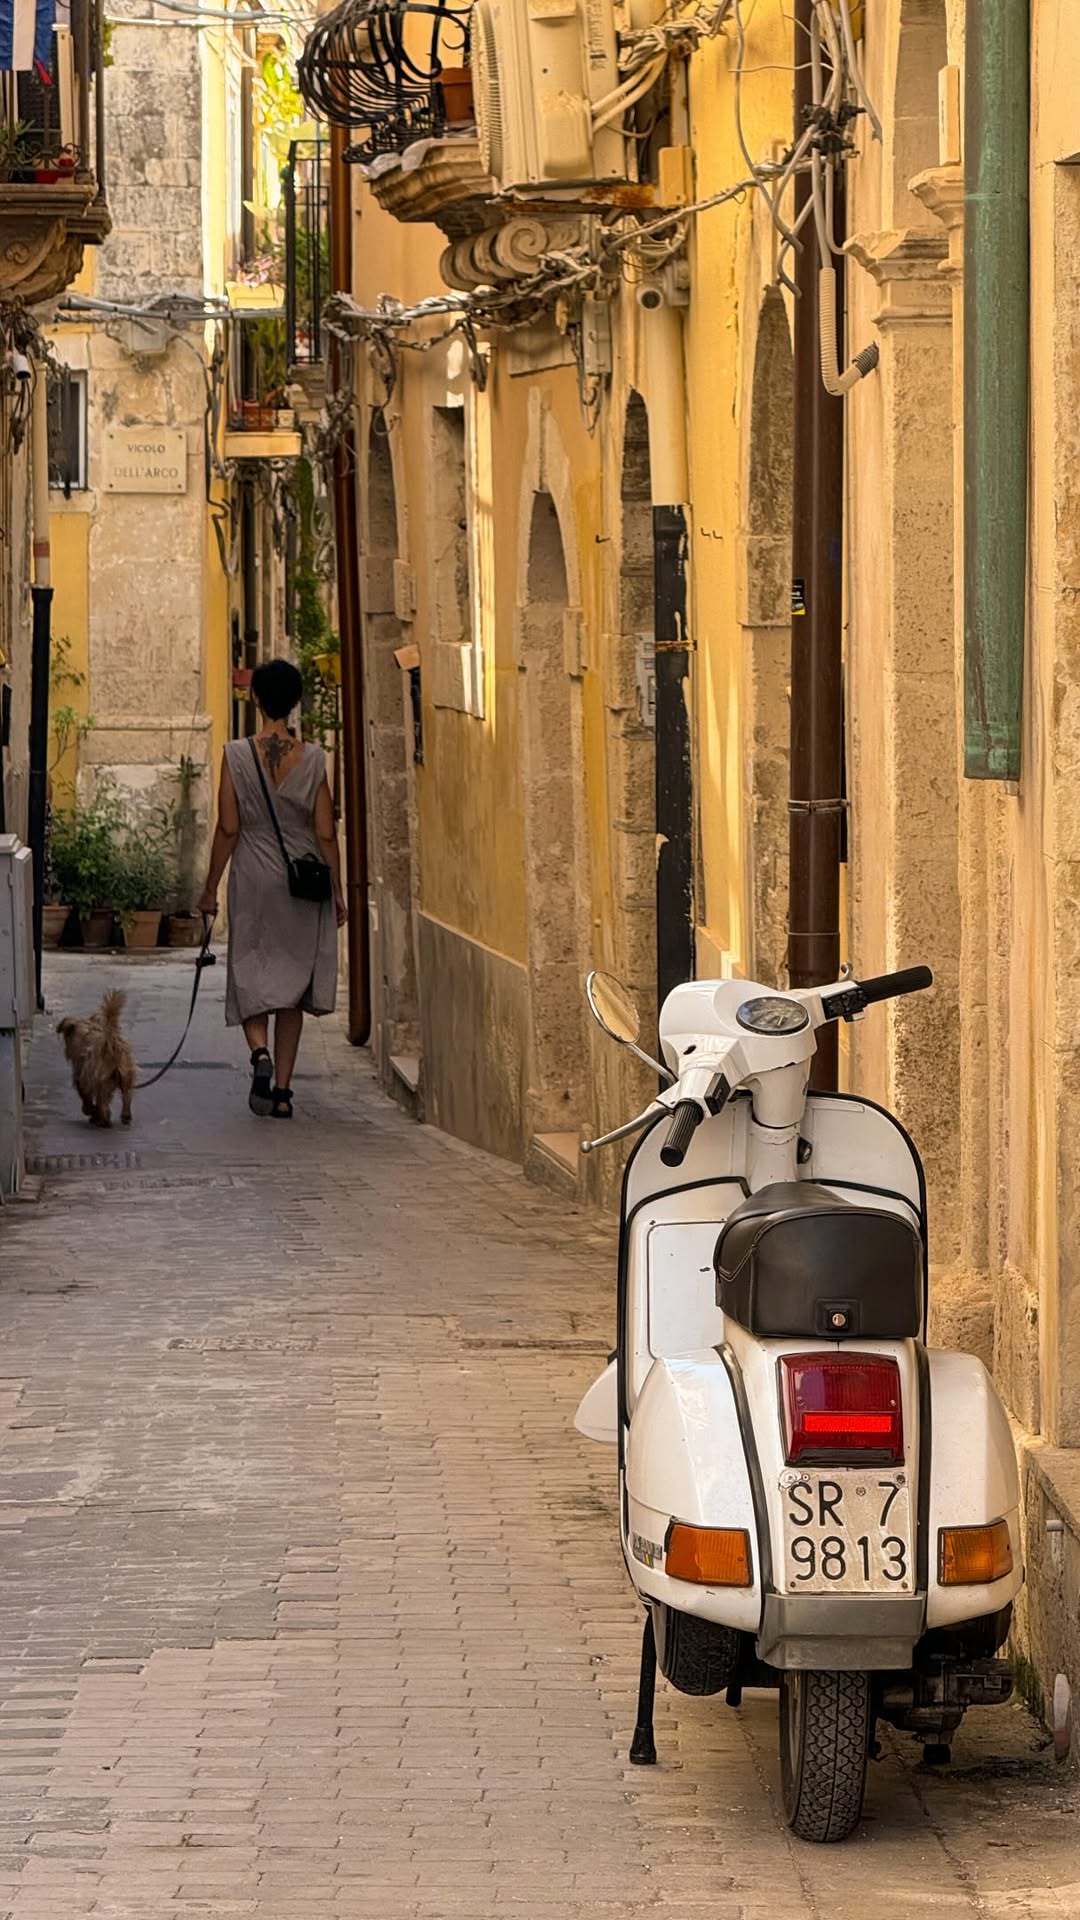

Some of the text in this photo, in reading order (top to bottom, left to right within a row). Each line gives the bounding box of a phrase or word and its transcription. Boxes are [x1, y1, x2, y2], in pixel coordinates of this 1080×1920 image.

[127, 443, 166, 454] VICOLO
[113, 466, 179, 478] DELL'ARCO
[788, 1481, 900, 1527] SR 7
[791, 1535, 907, 1581] 9813
